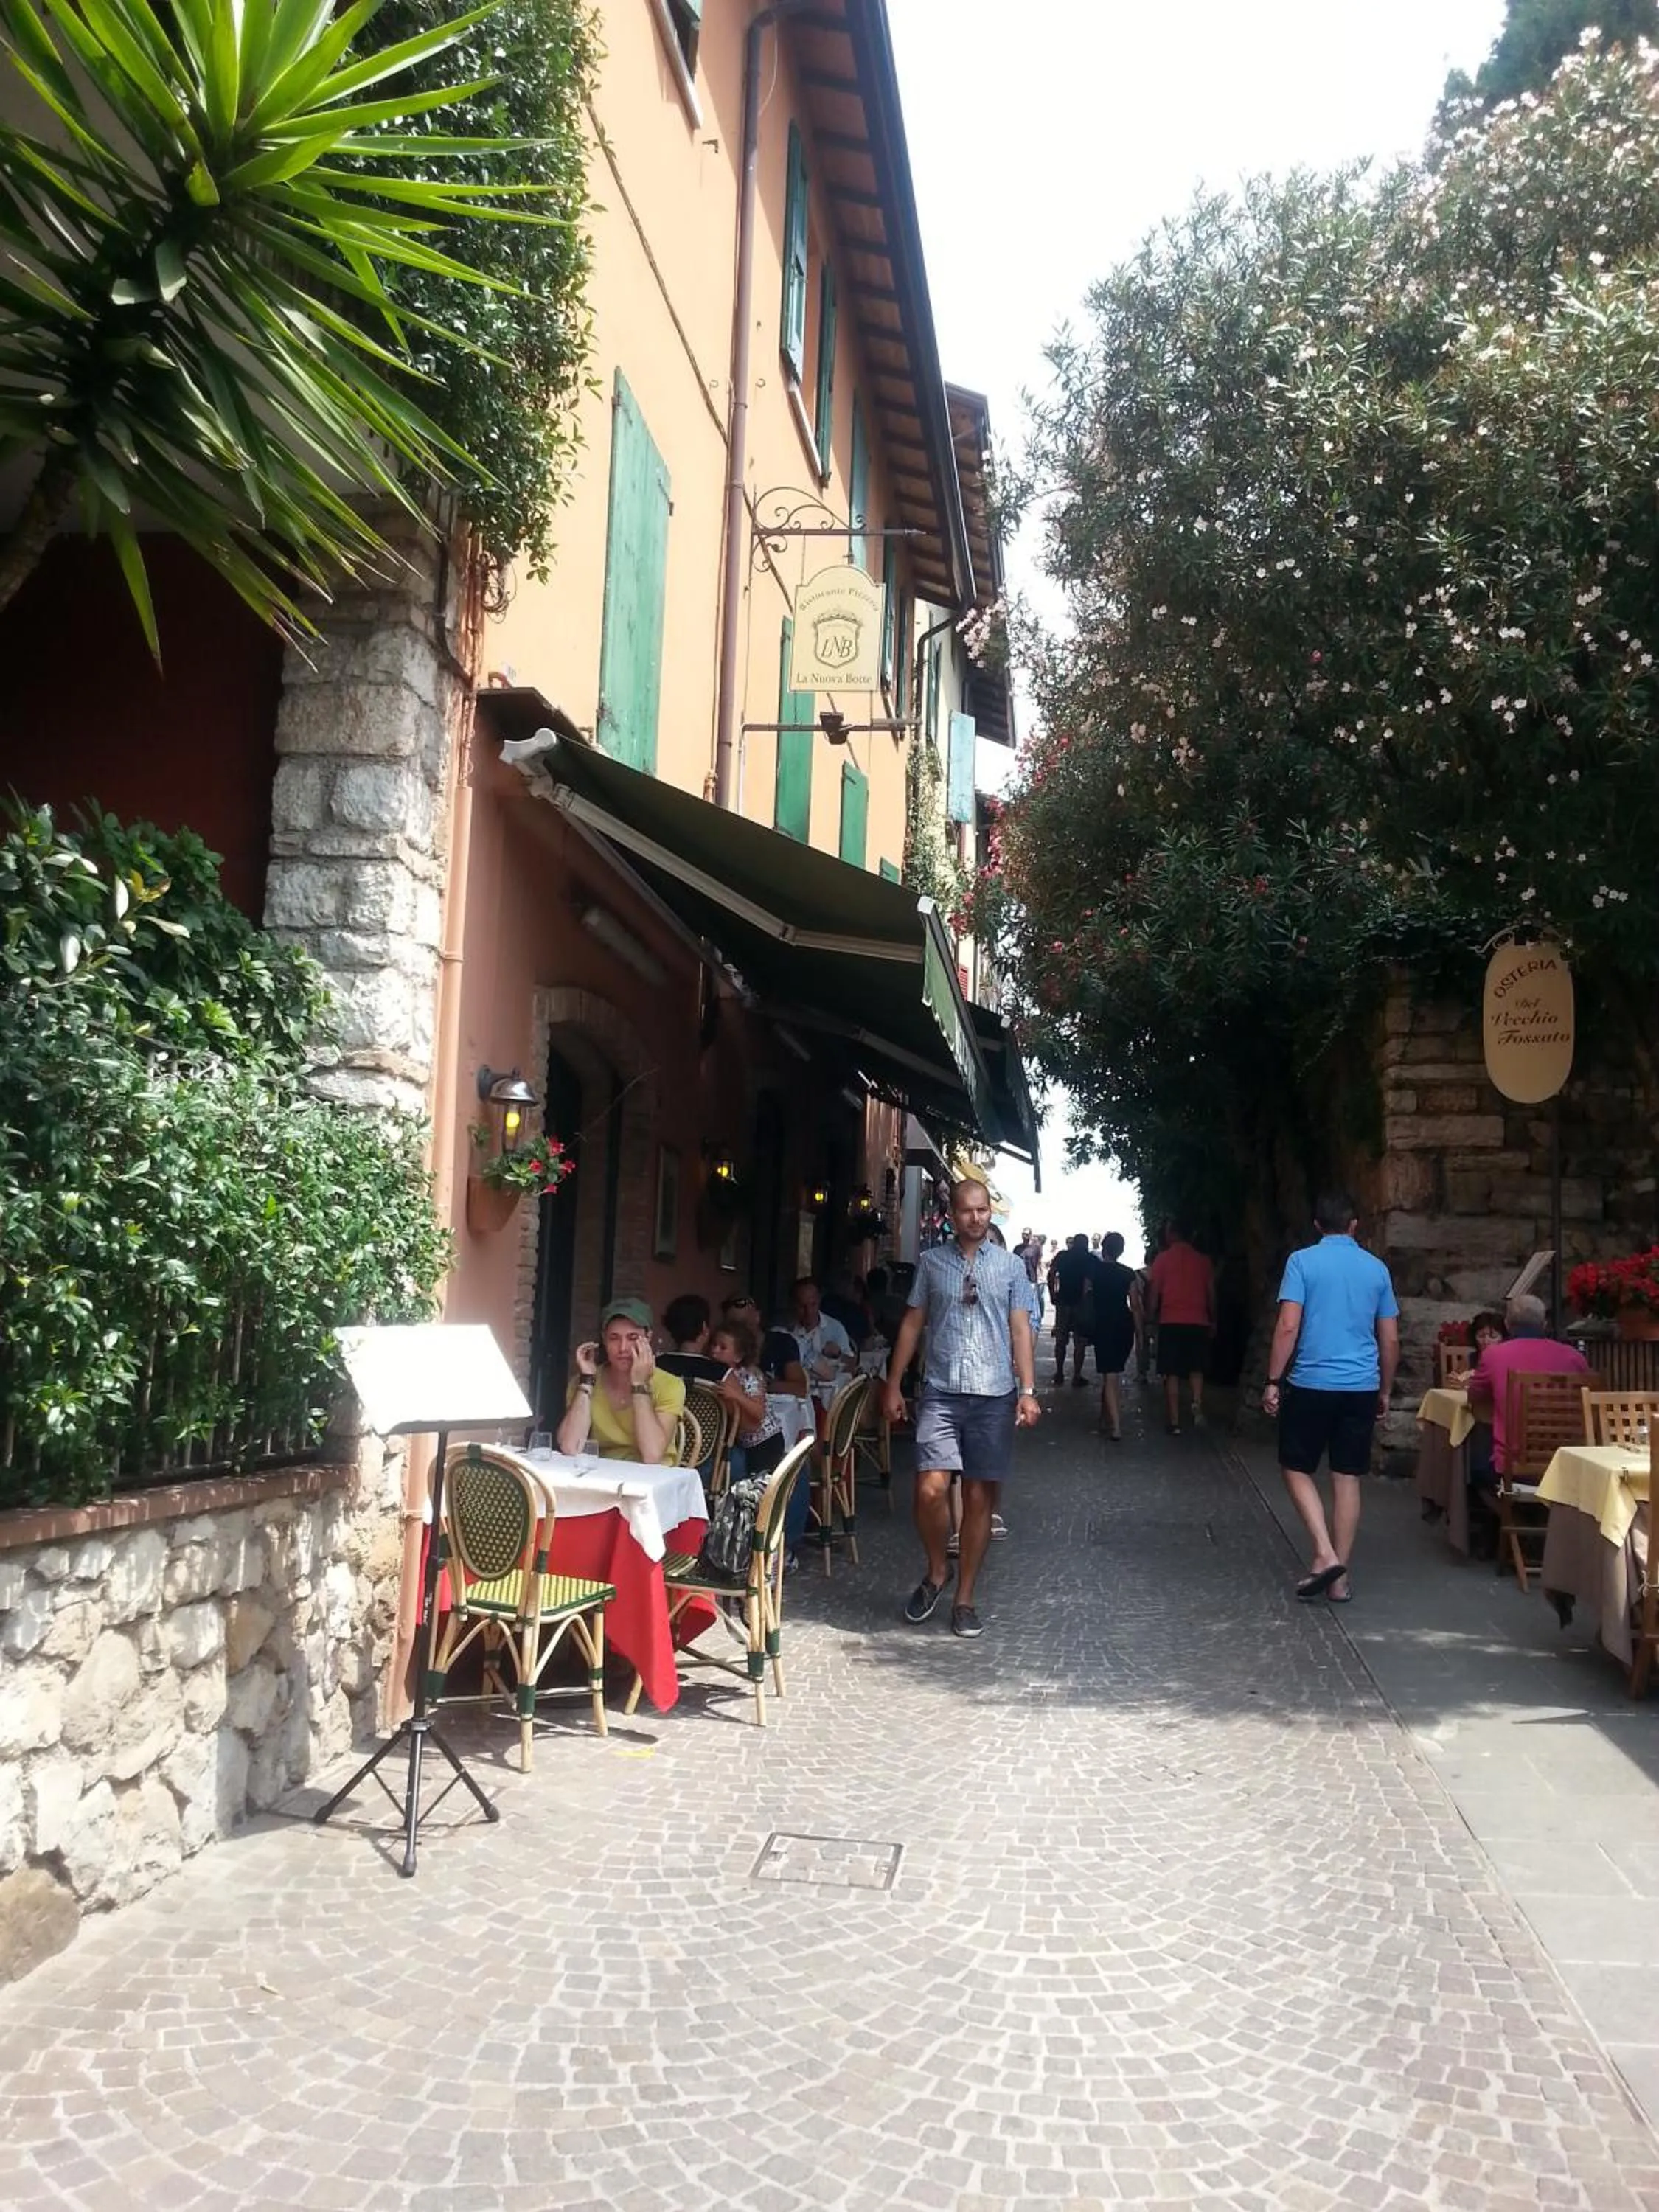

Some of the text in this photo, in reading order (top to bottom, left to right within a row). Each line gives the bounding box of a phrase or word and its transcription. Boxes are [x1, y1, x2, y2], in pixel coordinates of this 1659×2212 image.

[796, 672, 872, 684] La Nuova Botte
[1494, 959, 1557, 998] OSTERIA
[1491, 1010, 1559, 1026] Vecchio
[1498, 1029, 1571, 1045] Fossato
